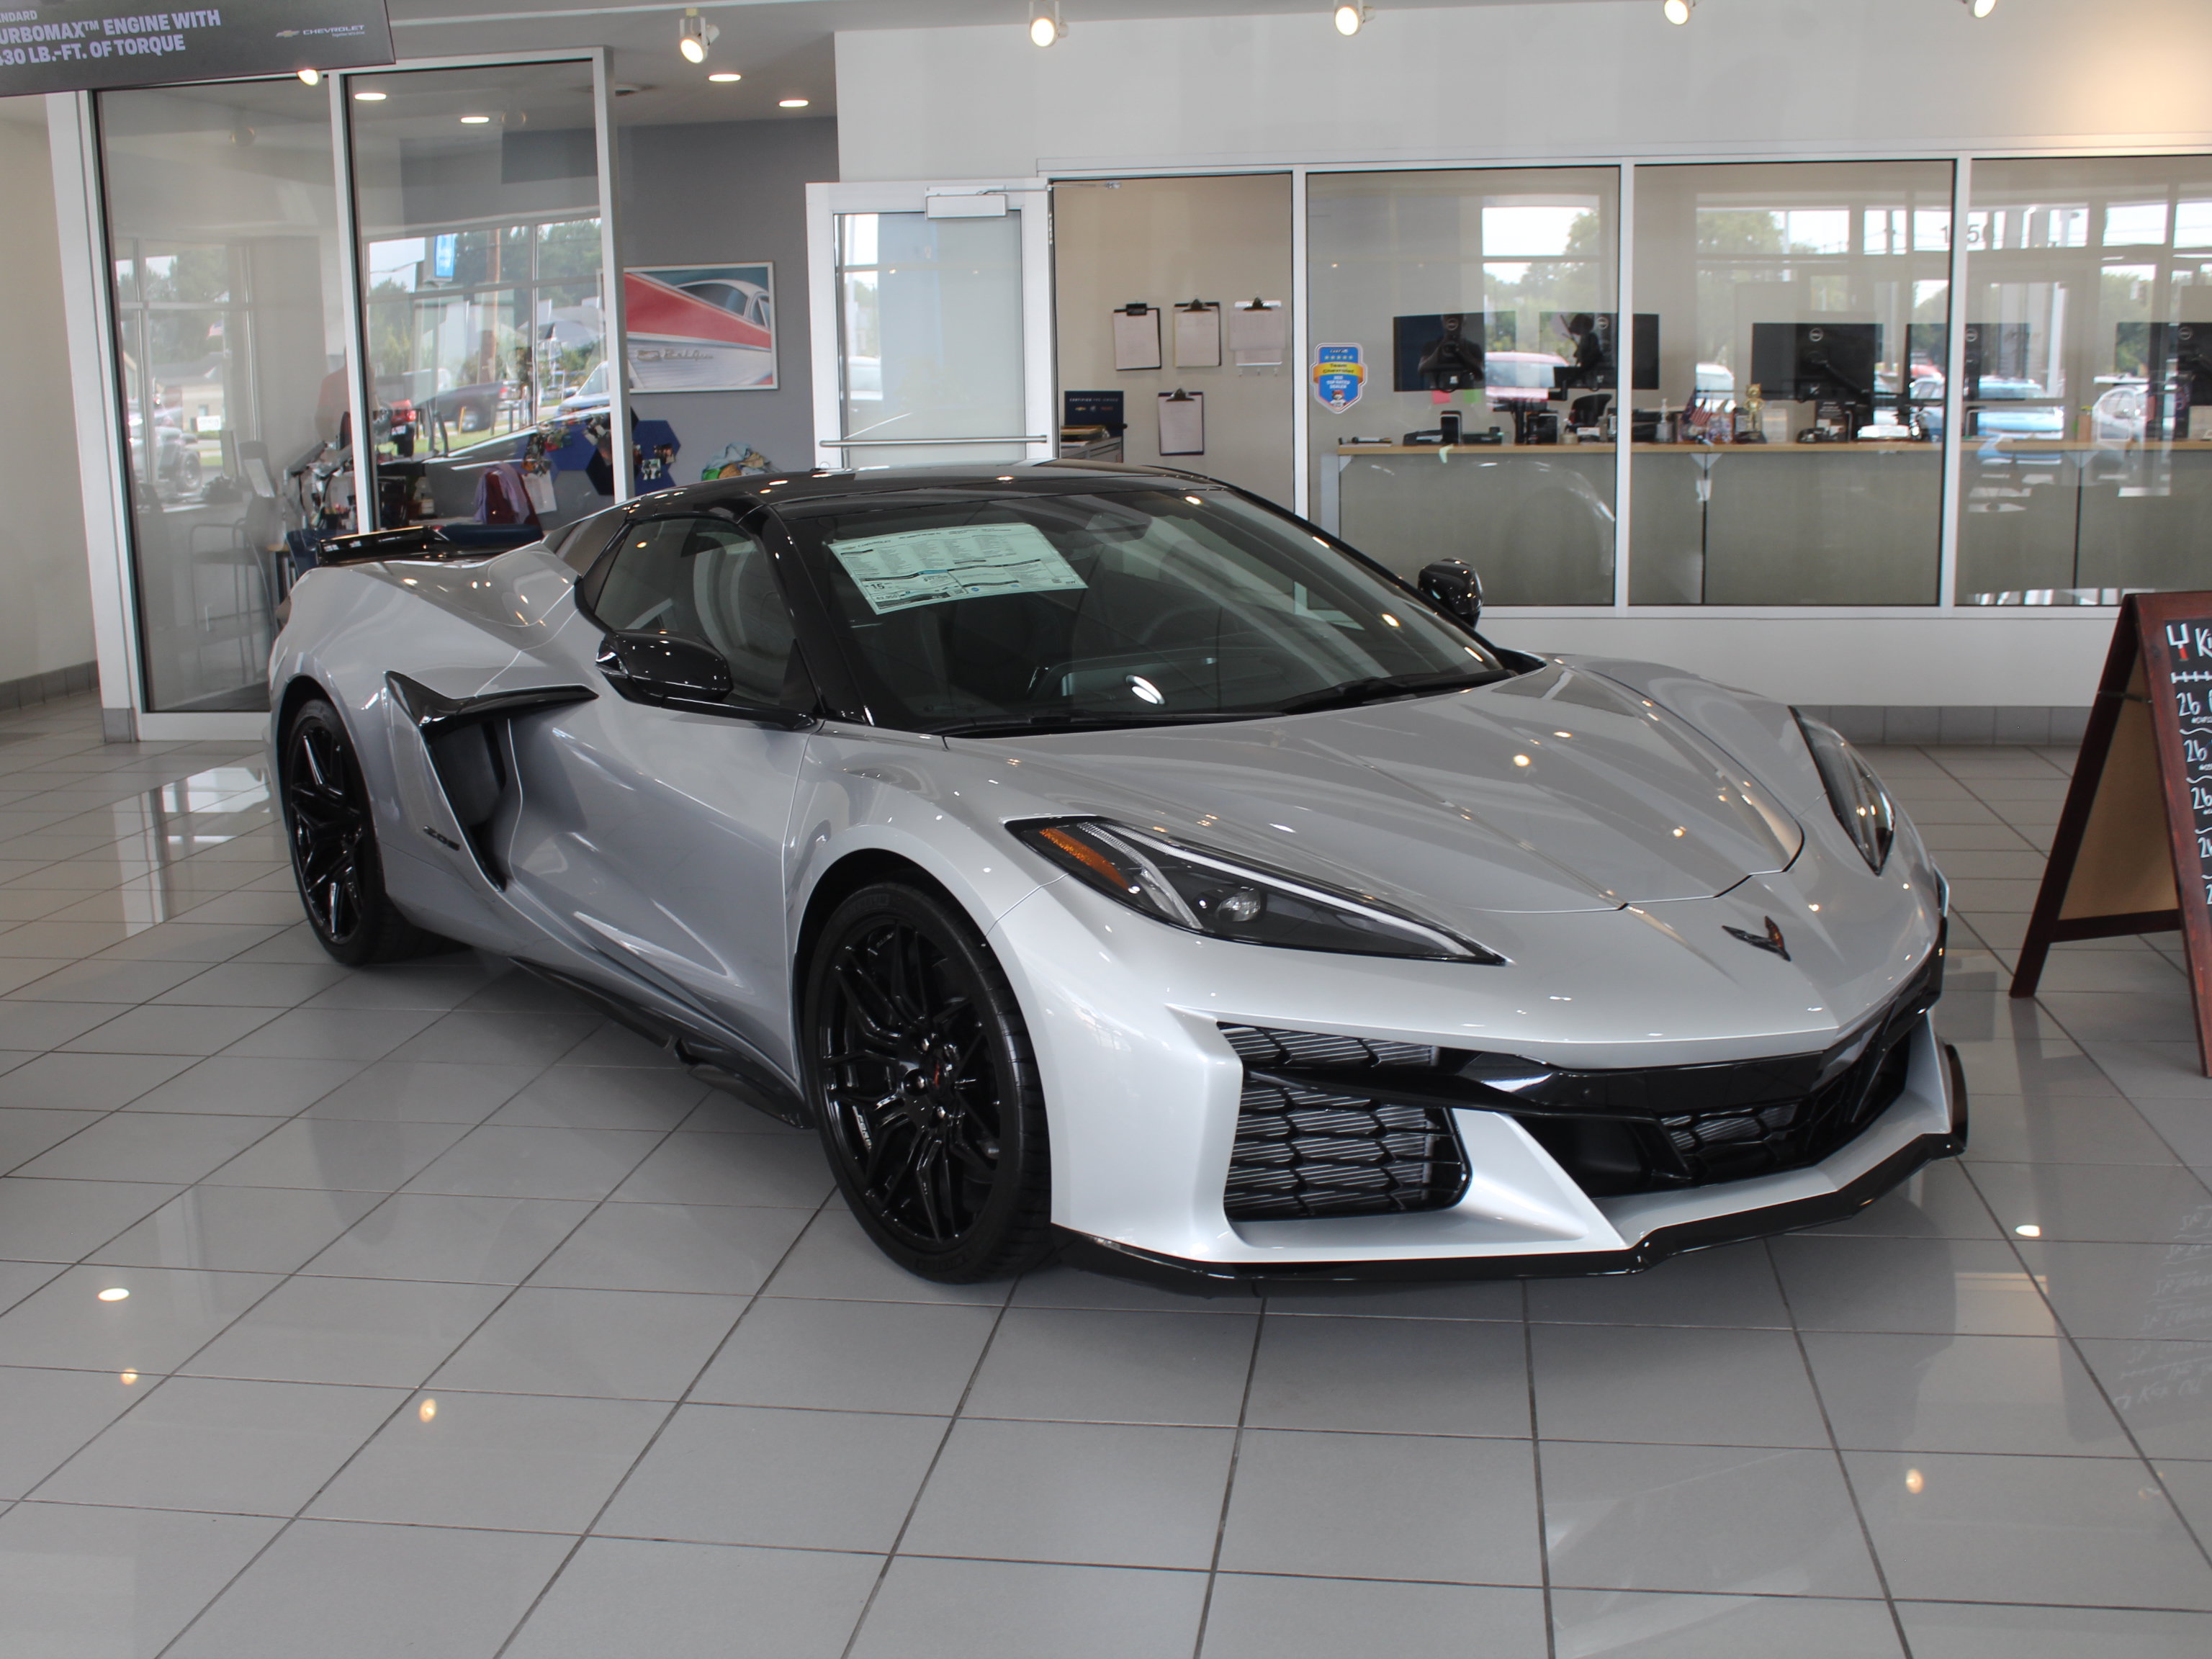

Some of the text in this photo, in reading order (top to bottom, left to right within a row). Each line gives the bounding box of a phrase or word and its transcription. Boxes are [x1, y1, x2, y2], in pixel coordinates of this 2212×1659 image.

[103, 14, 170, 35] ENGINE
[171, 9, 221, 29] WITH
[303, 24, 364, 35] CHEVROLET
[28, 42, 87, 63] LB.-FT.
[90, 40, 112, 58] OF
[113, 34, 186, 56] TORQUE
